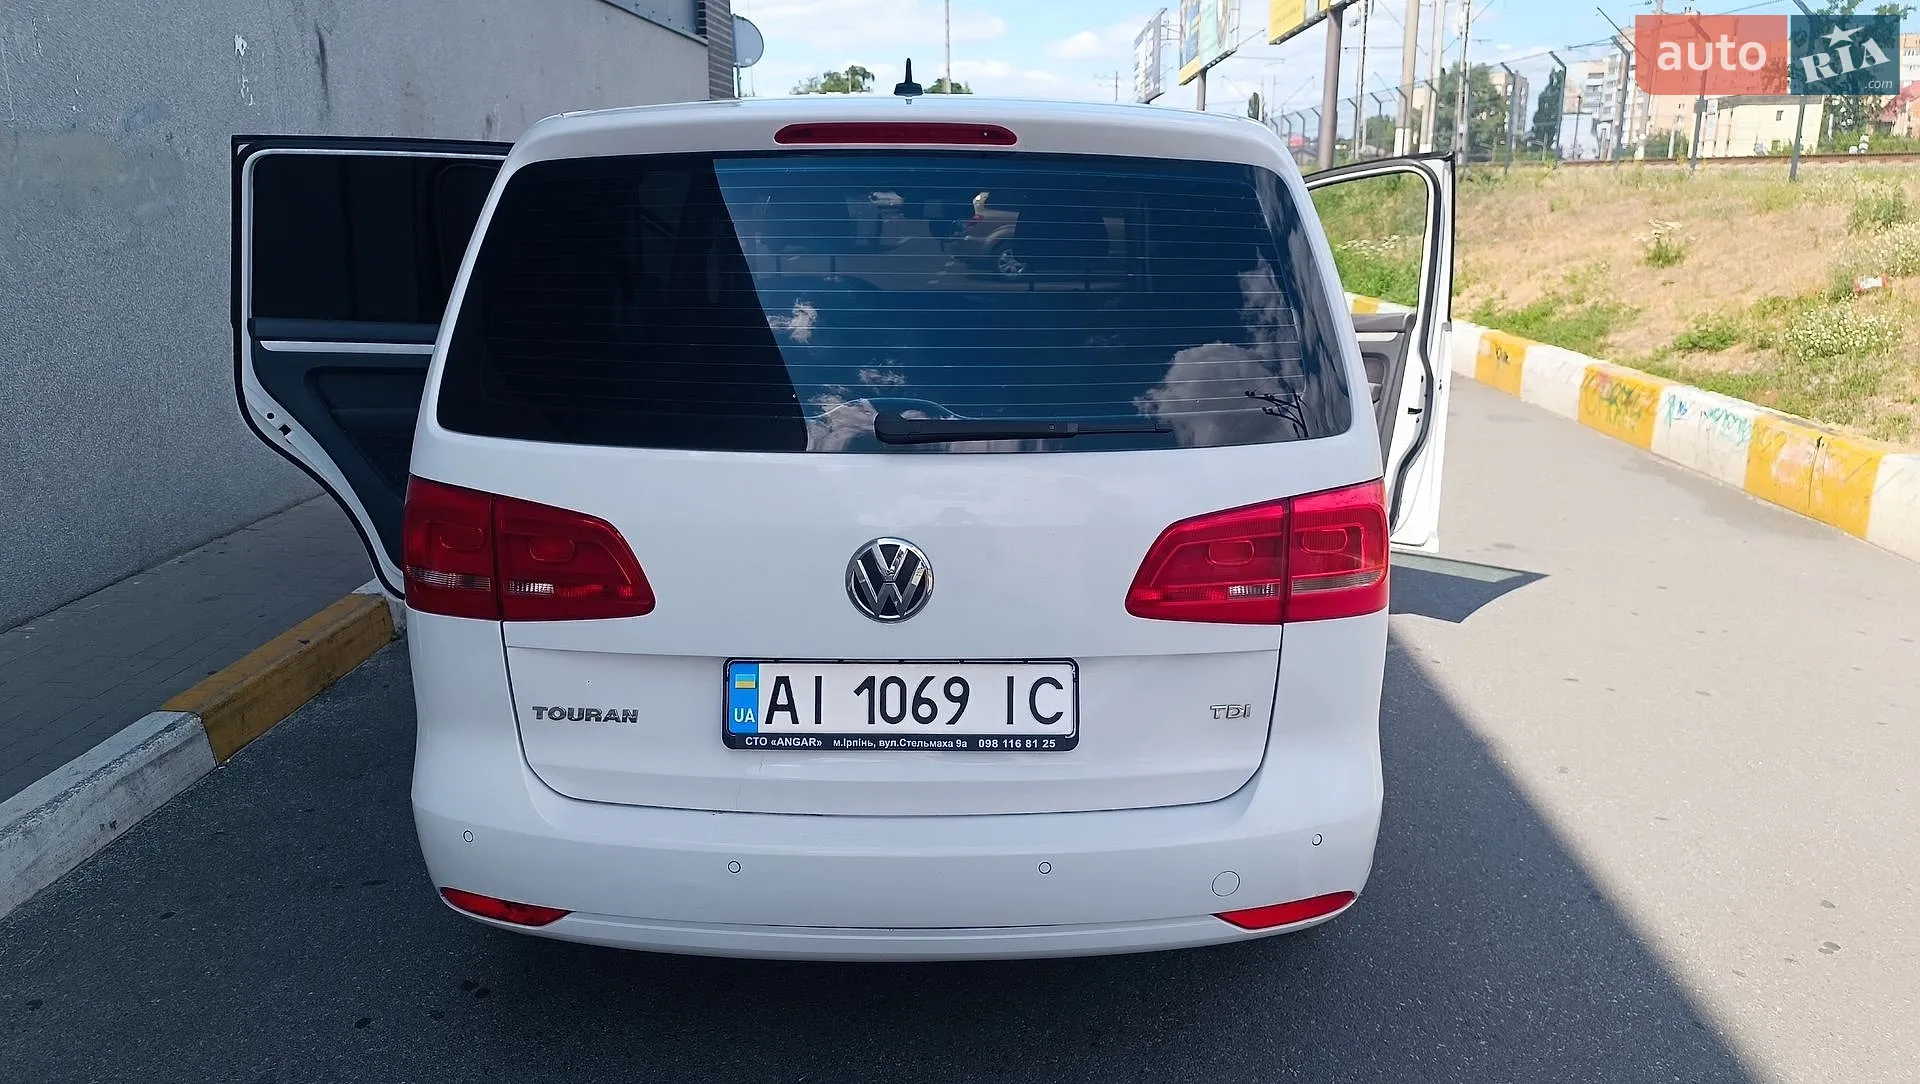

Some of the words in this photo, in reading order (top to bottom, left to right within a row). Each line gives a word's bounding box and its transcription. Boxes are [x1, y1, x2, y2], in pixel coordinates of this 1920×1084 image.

[764, 675, 823, 725] AI
[853, 675, 970, 726] 1069
[1006, 675, 1065, 726] IC
[532, 706, 639, 723] TOURAN
[734, 707, 756, 724] UA
[1209, 704, 1251, 719] TDI
[978, 739, 999, 748] 098
[1002, 739, 1022, 748] 116
[1025, 739, 1039, 748] 81
[1042, 739, 1056, 748] 25
